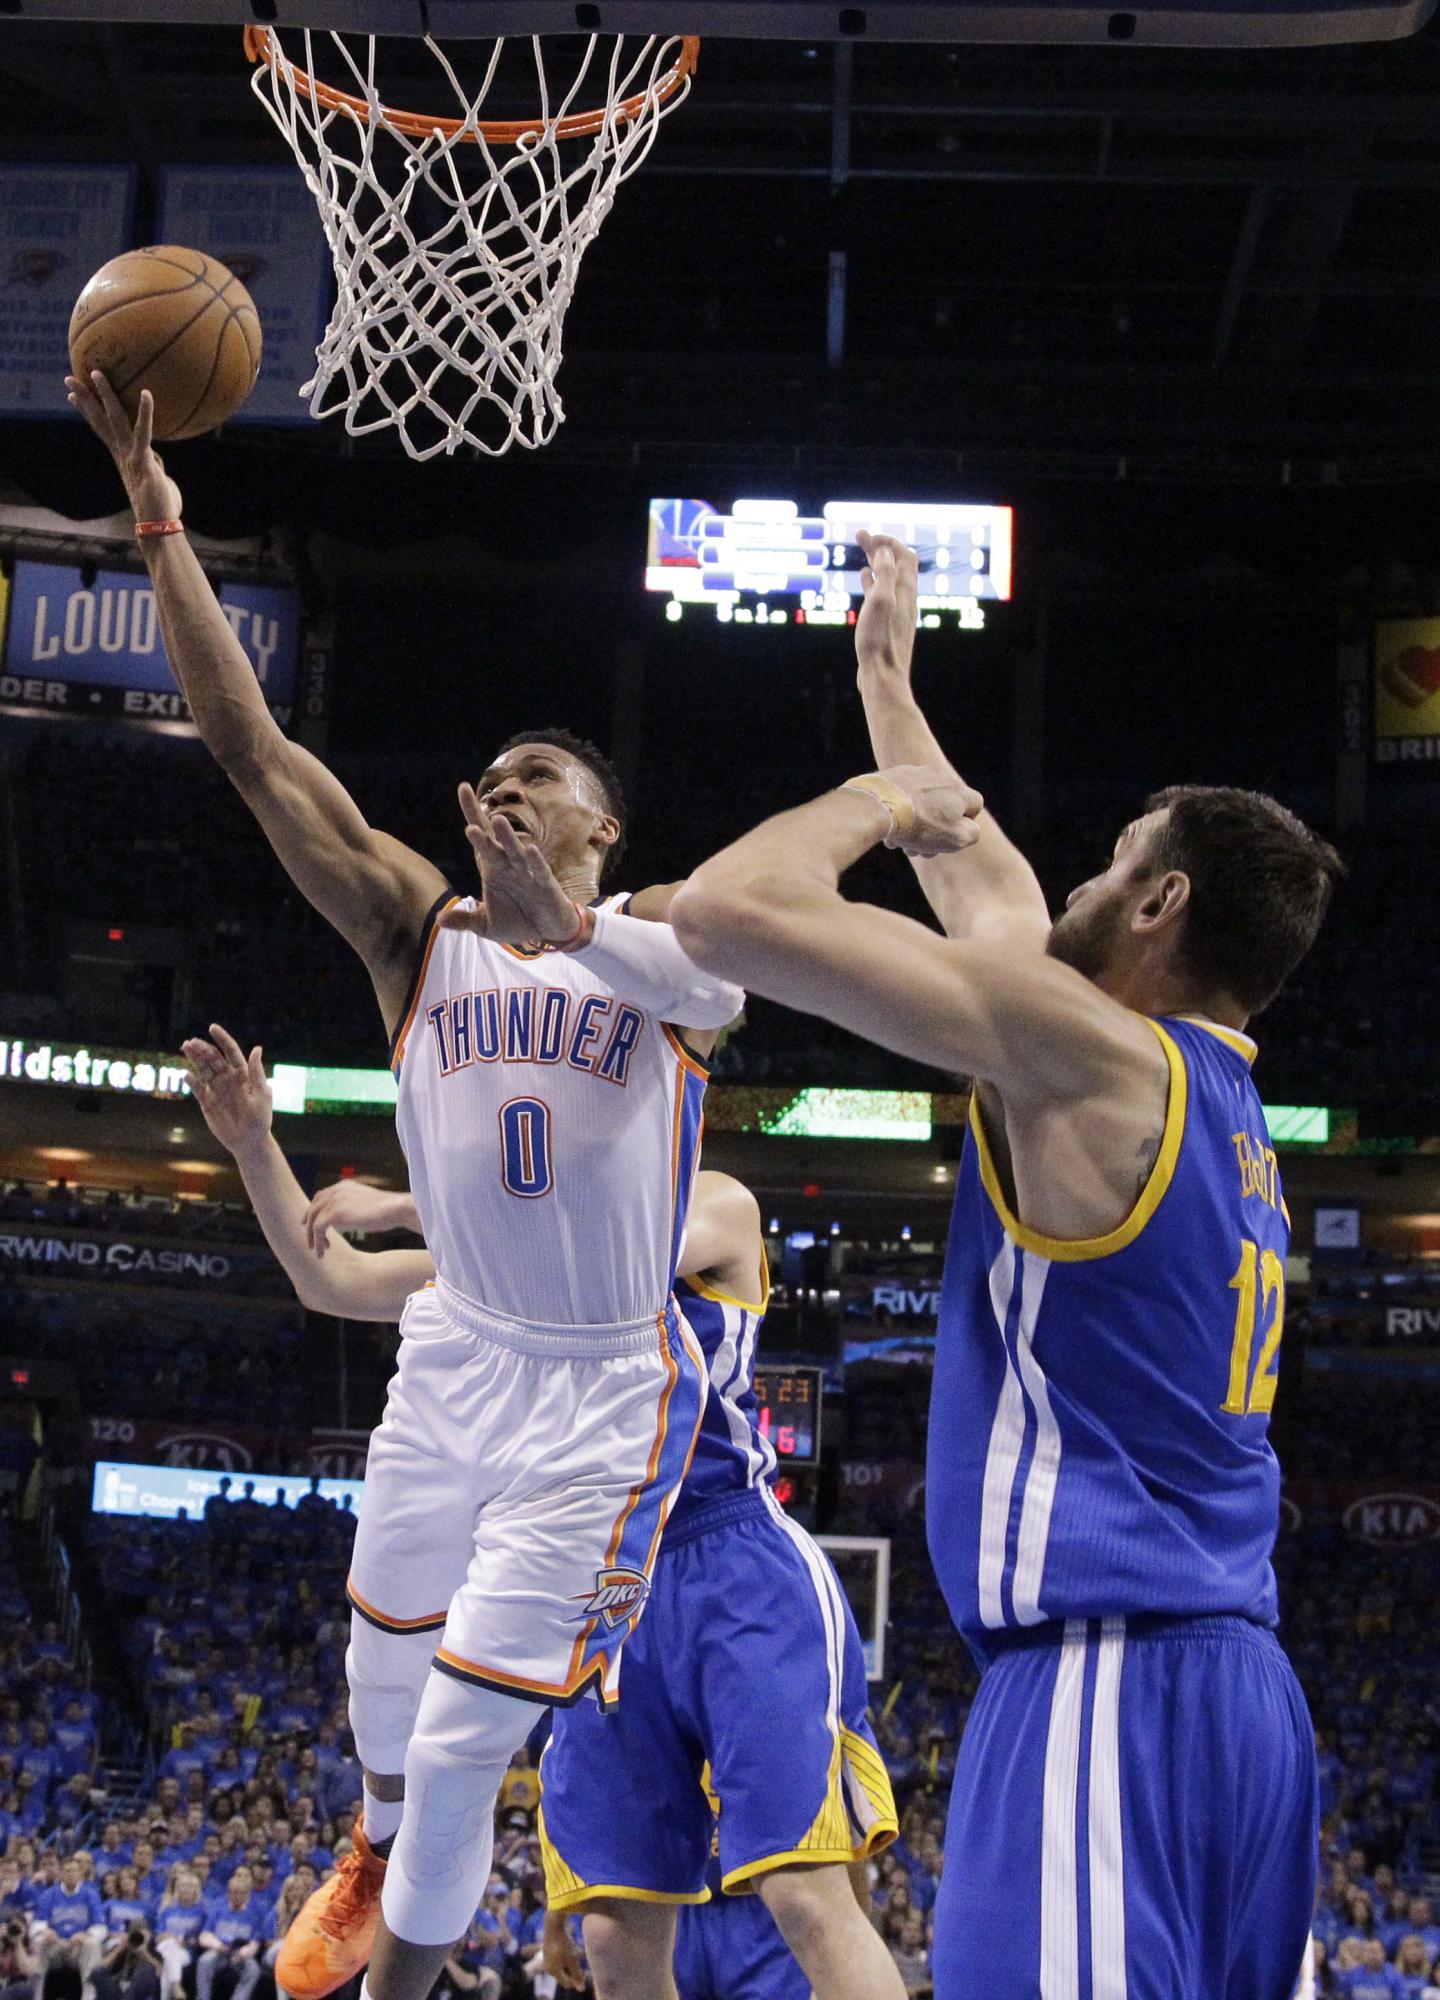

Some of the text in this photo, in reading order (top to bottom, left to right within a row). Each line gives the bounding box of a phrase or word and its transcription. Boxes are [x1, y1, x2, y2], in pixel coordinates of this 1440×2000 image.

[32, 589, 157, 662] LOUD
[0, 676, 68, 704] DER
[426, 987, 644, 1087] THUNDER
[498, 1095, 553, 1198] 0
[105, 1243, 230, 1278] CASINO
[1218, 1238, 1285, 1416] 12
[1361, 1504, 1427, 1535] KIA
[583, 1583, 640, 1614] OKC
